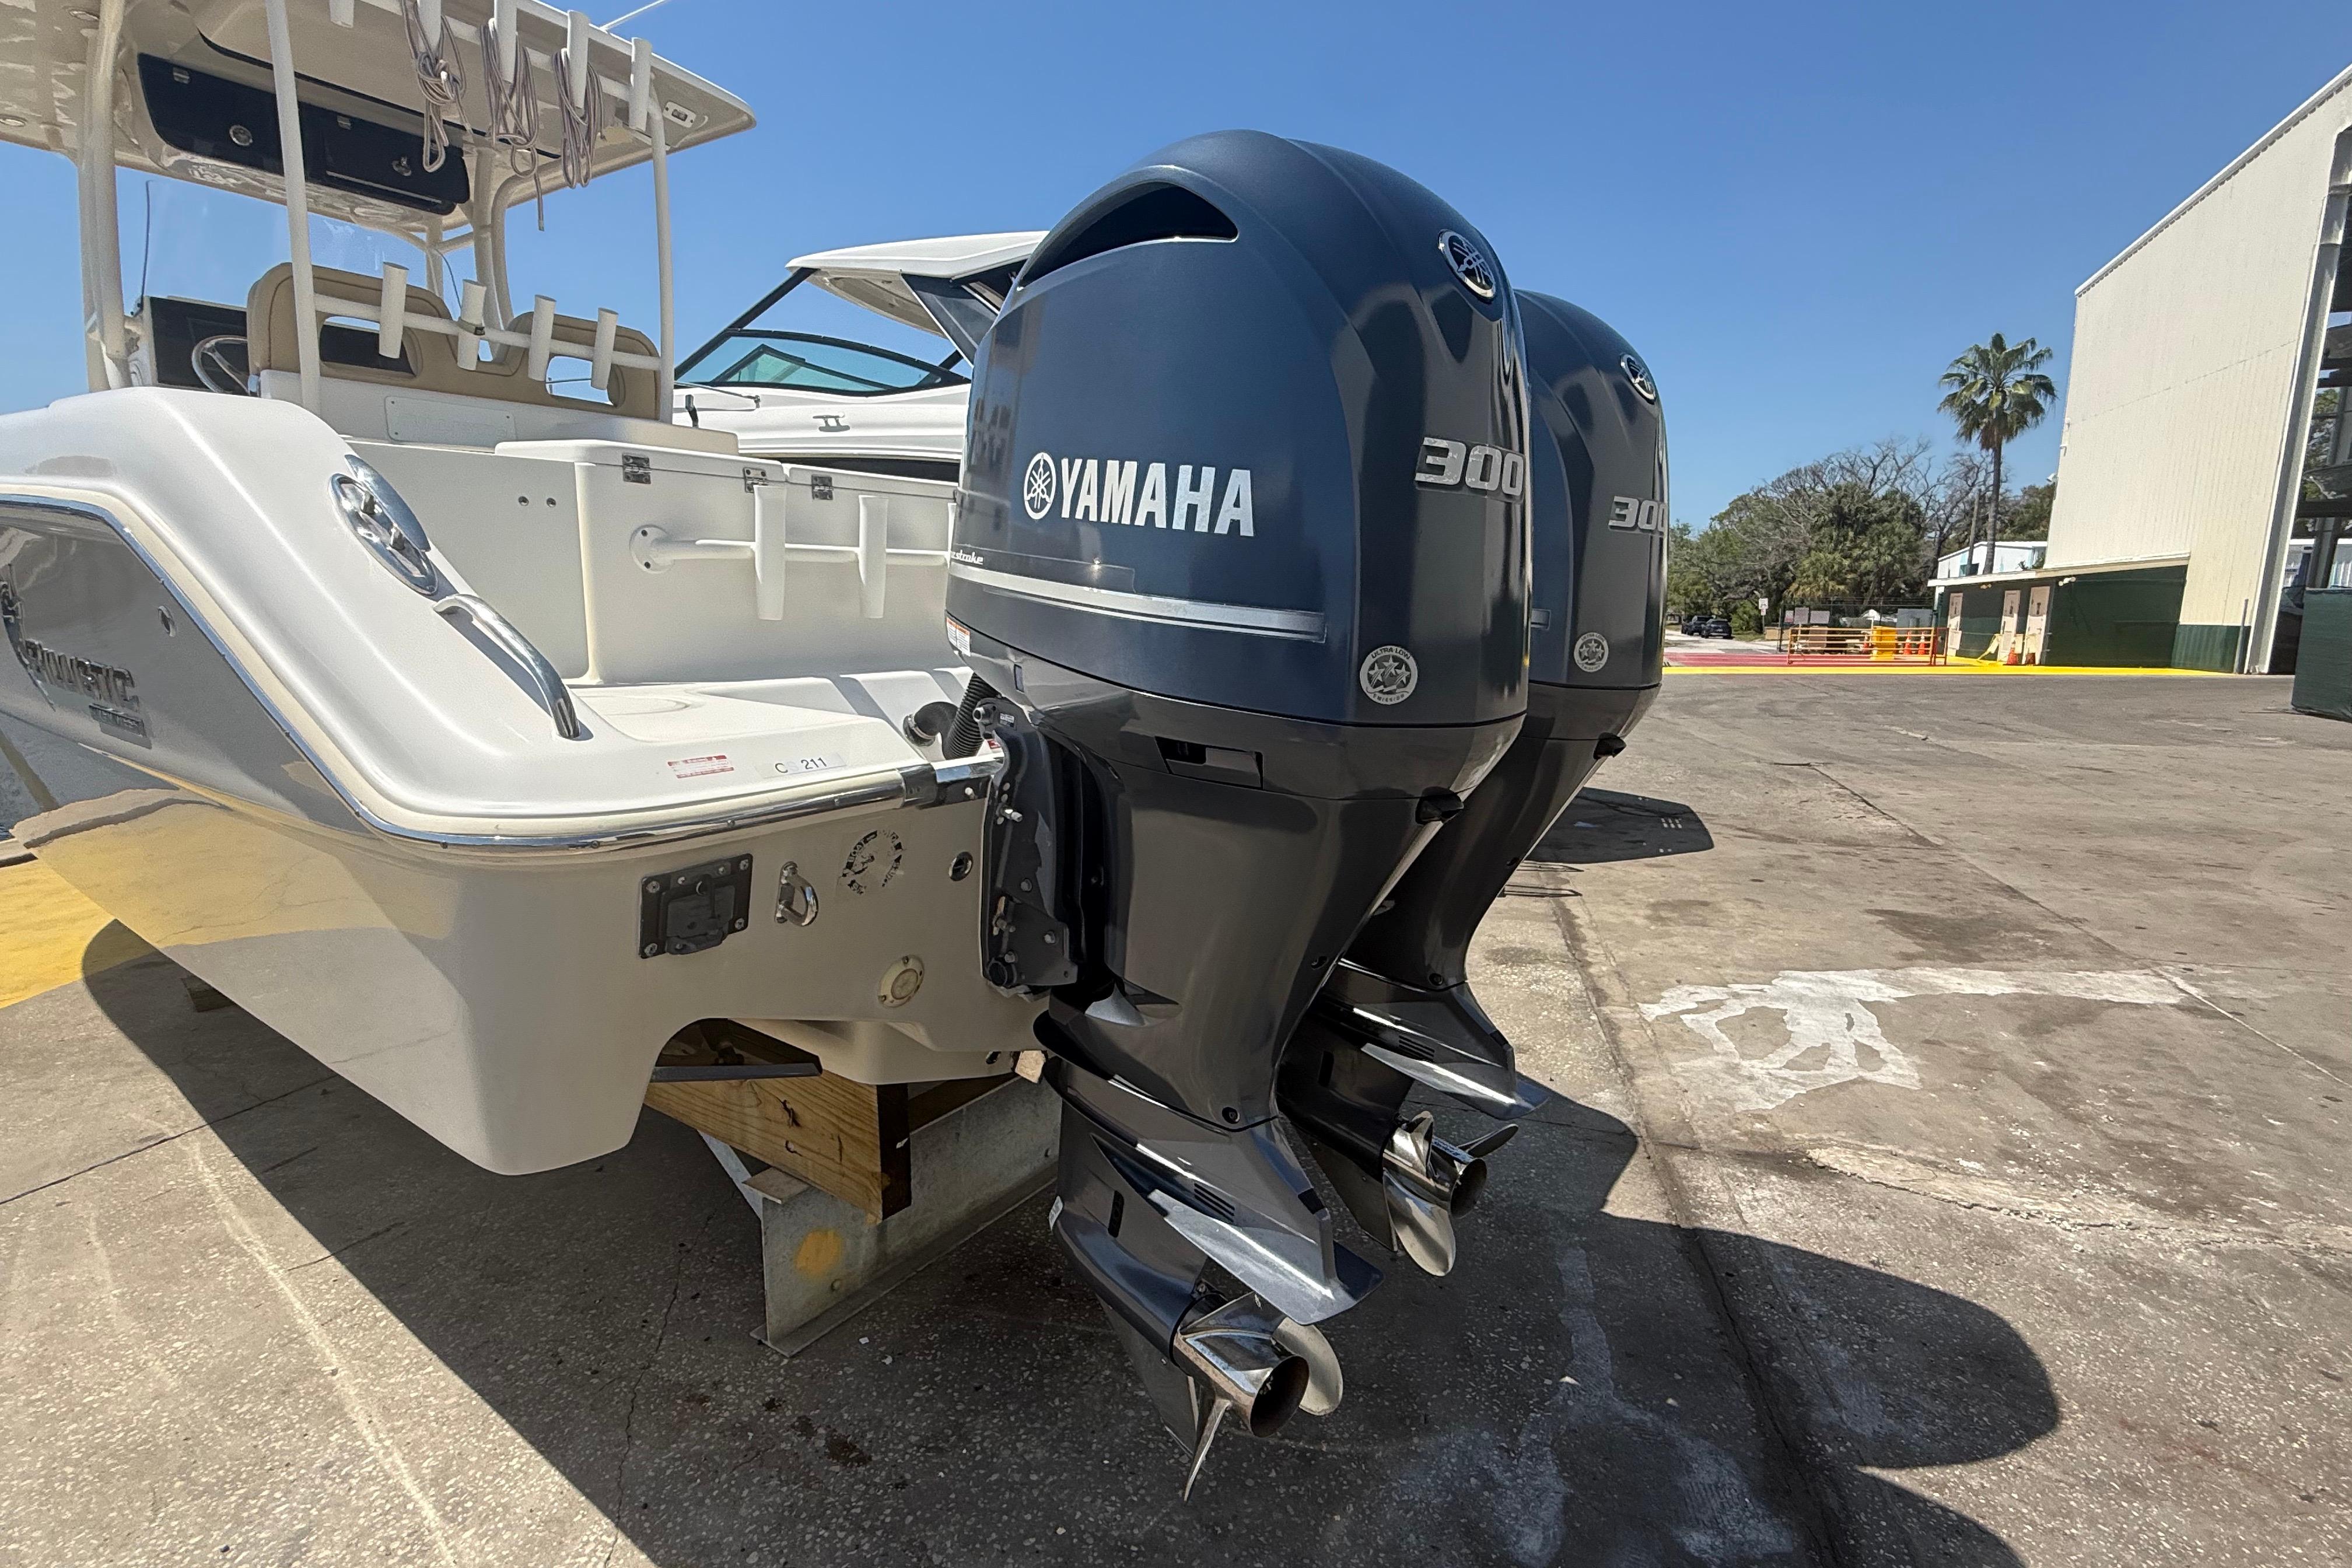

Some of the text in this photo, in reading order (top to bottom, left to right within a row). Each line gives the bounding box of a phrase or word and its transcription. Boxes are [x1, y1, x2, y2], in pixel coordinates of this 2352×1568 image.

[1415, 437, 1524, 496] 300
[1062, 458, 1254, 537] YAMAHA
[1608, 496, 1667, 532] 300
[801, 757, 827, 770] 211
